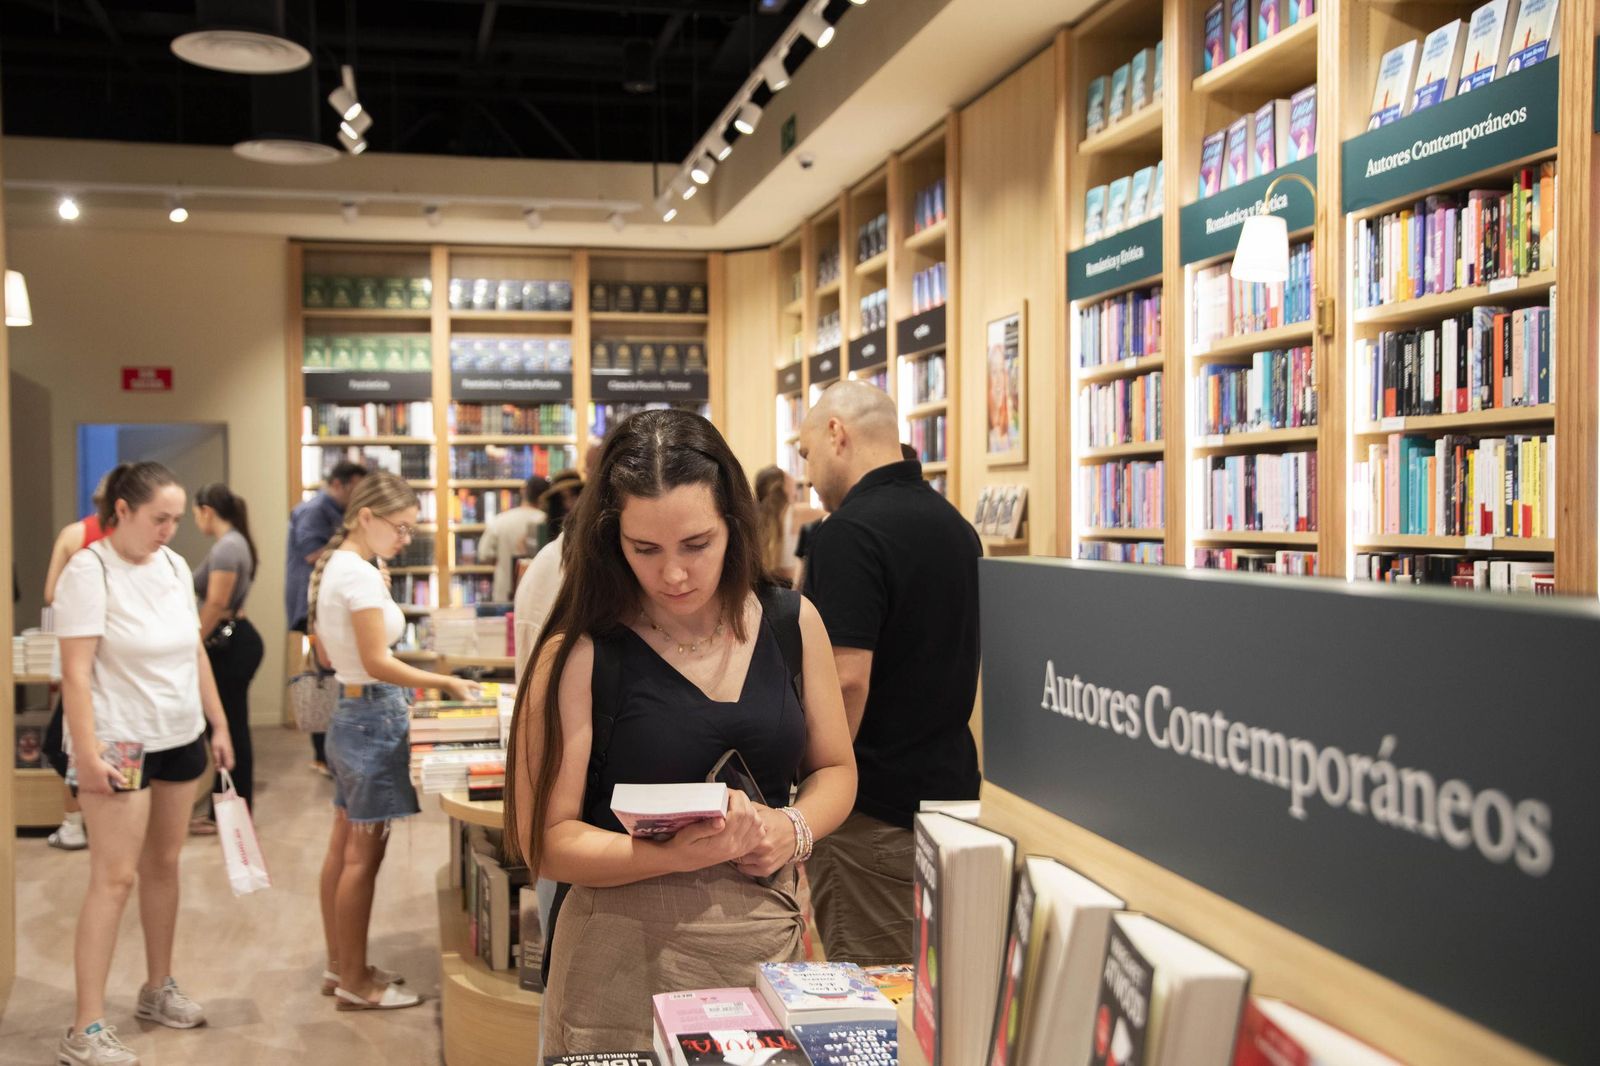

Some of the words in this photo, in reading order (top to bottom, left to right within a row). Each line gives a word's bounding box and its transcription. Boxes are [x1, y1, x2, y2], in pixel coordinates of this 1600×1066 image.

[1365, 148, 1411, 177] Autores
[1411, 106, 1527, 159] Contemporáneos
[1041, 659, 1141, 739] Autores
[1144, 683, 1555, 877] Contemporáneos
